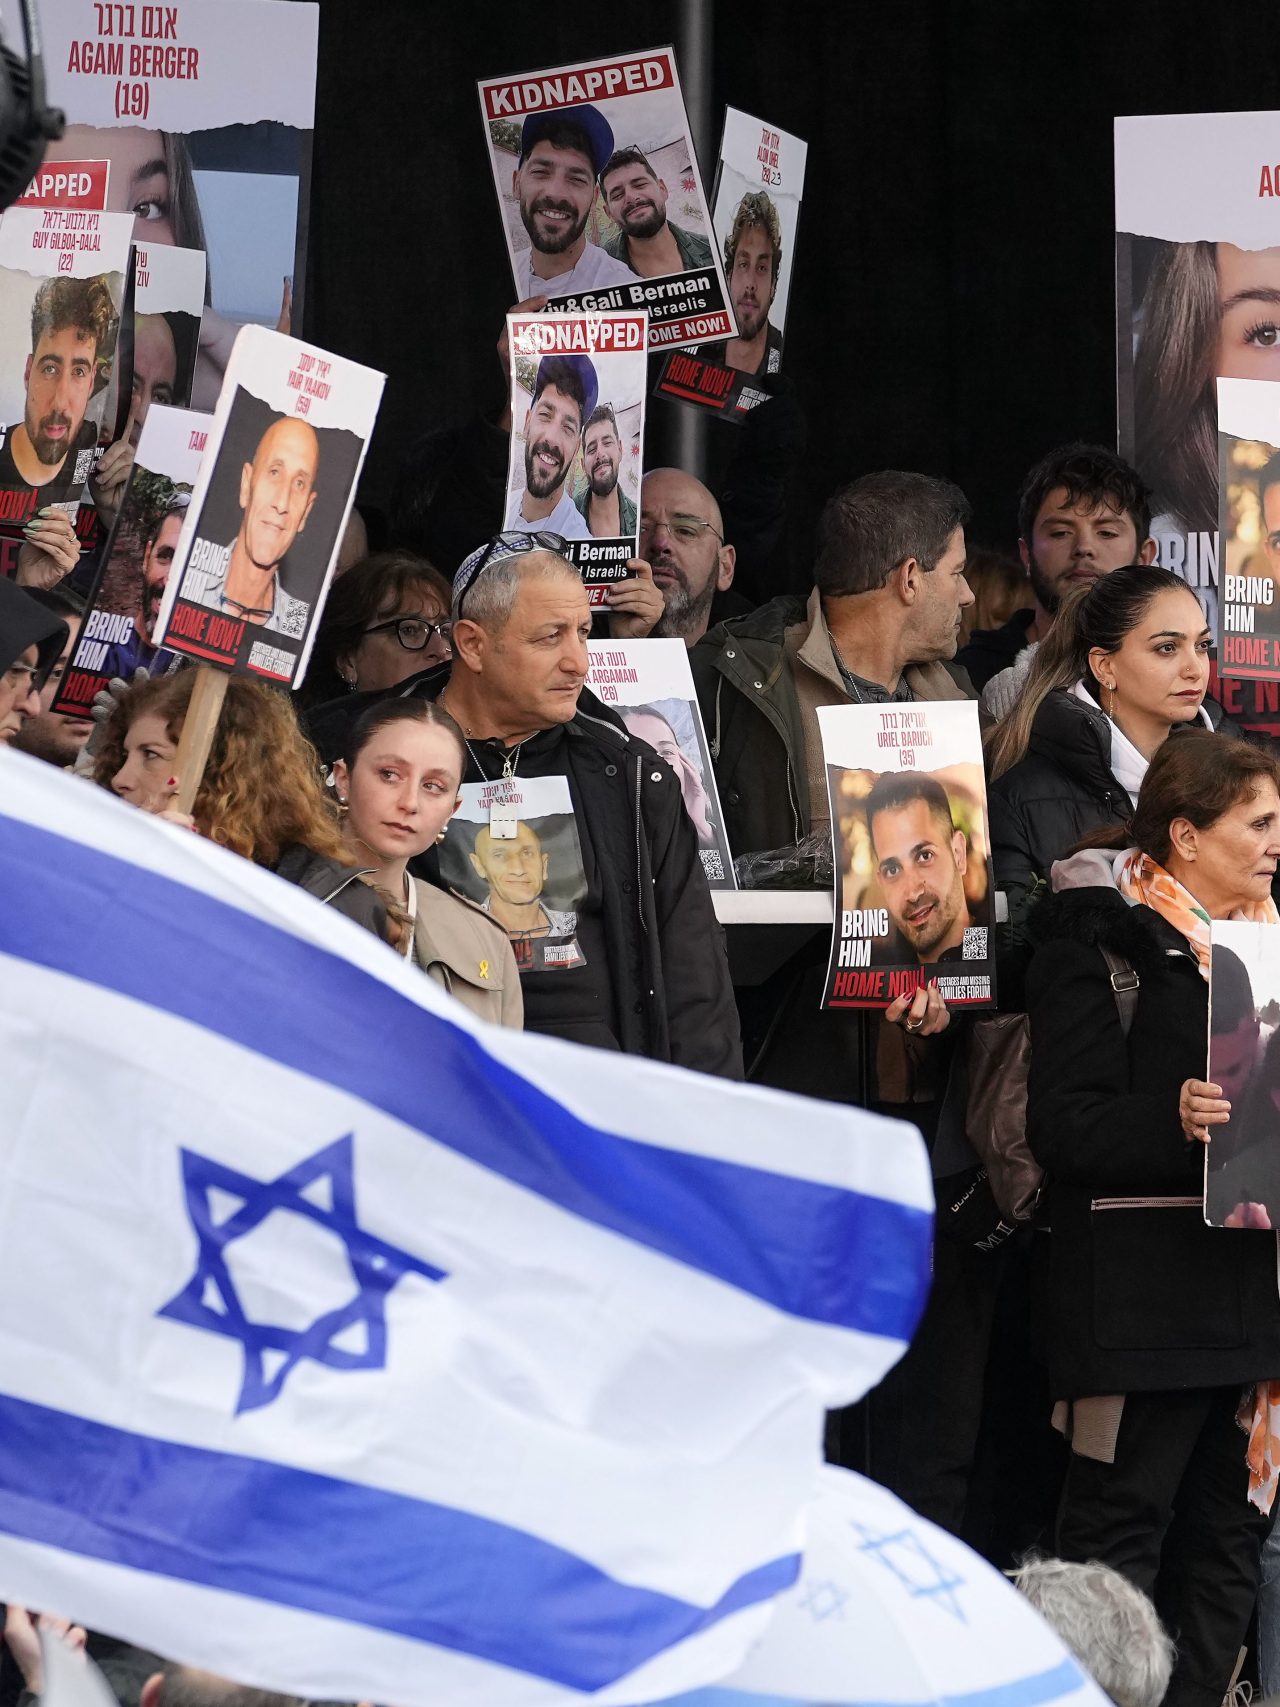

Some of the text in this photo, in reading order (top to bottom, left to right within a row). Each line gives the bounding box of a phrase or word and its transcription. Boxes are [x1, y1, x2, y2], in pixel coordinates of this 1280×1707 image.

[94, 3, 177, 39] אגם ברגר
[67, 41, 199, 80] AGAM BERGER
[115, 82, 149, 119] (19)
[490, 61, 665, 114] KIDNAPPED
[771, 171, 781, 186] 23
[32, 232, 101, 251] GUY GILBOA-DALAL
[58, 254, 74, 272] (22)
[137, 270, 150, 287] ZIV
[629, 276, 711, 303] Berman
[650, 297, 707, 318] Israelis
[518, 322, 640, 350] KIDNAPPED
[685, 317, 726, 339] NOW!
[287, 370, 332, 400] YAIR YAAKOV
[666, 354, 702, 388] HOME
[699, 366, 736, 399] NOW!
[295, 397, 312, 416] (59)
[189, 538, 230, 578] BRING
[579, 543, 631, 561] Berman
[586, 565, 627, 578] Israelis
[180, 571, 207, 600] HIM
[1224, 574, 1274, 605] BRING
[83, 610, 134, 645] BRING
[169, 603, 209, 640] HOME
[205, 617, 246, 654] NOW!
[1224, 604, 1255, 633] HIM
[72, 638, 110, 671] HIM
[606, 652, 627, 666] נועה
[1224, 636, 1269, 666] HOME
[592, 669, 638, 684] ARGAMANI
[600, 685, 618, 702] (26)
[879, 712, 928, 731] אוריאל ברוך
[877, 730, 933, 748] URIEL BARUCH
[899, 749, 916, 767] (35)
[841, 908, 889, 938] BRING
[838, 940, 872, 967] HIM
[833, 965, 926, 998] HOME NOW!
[960, 976, 990, 985] AND MISSING
[966, 985, 991, 999] FORUM
